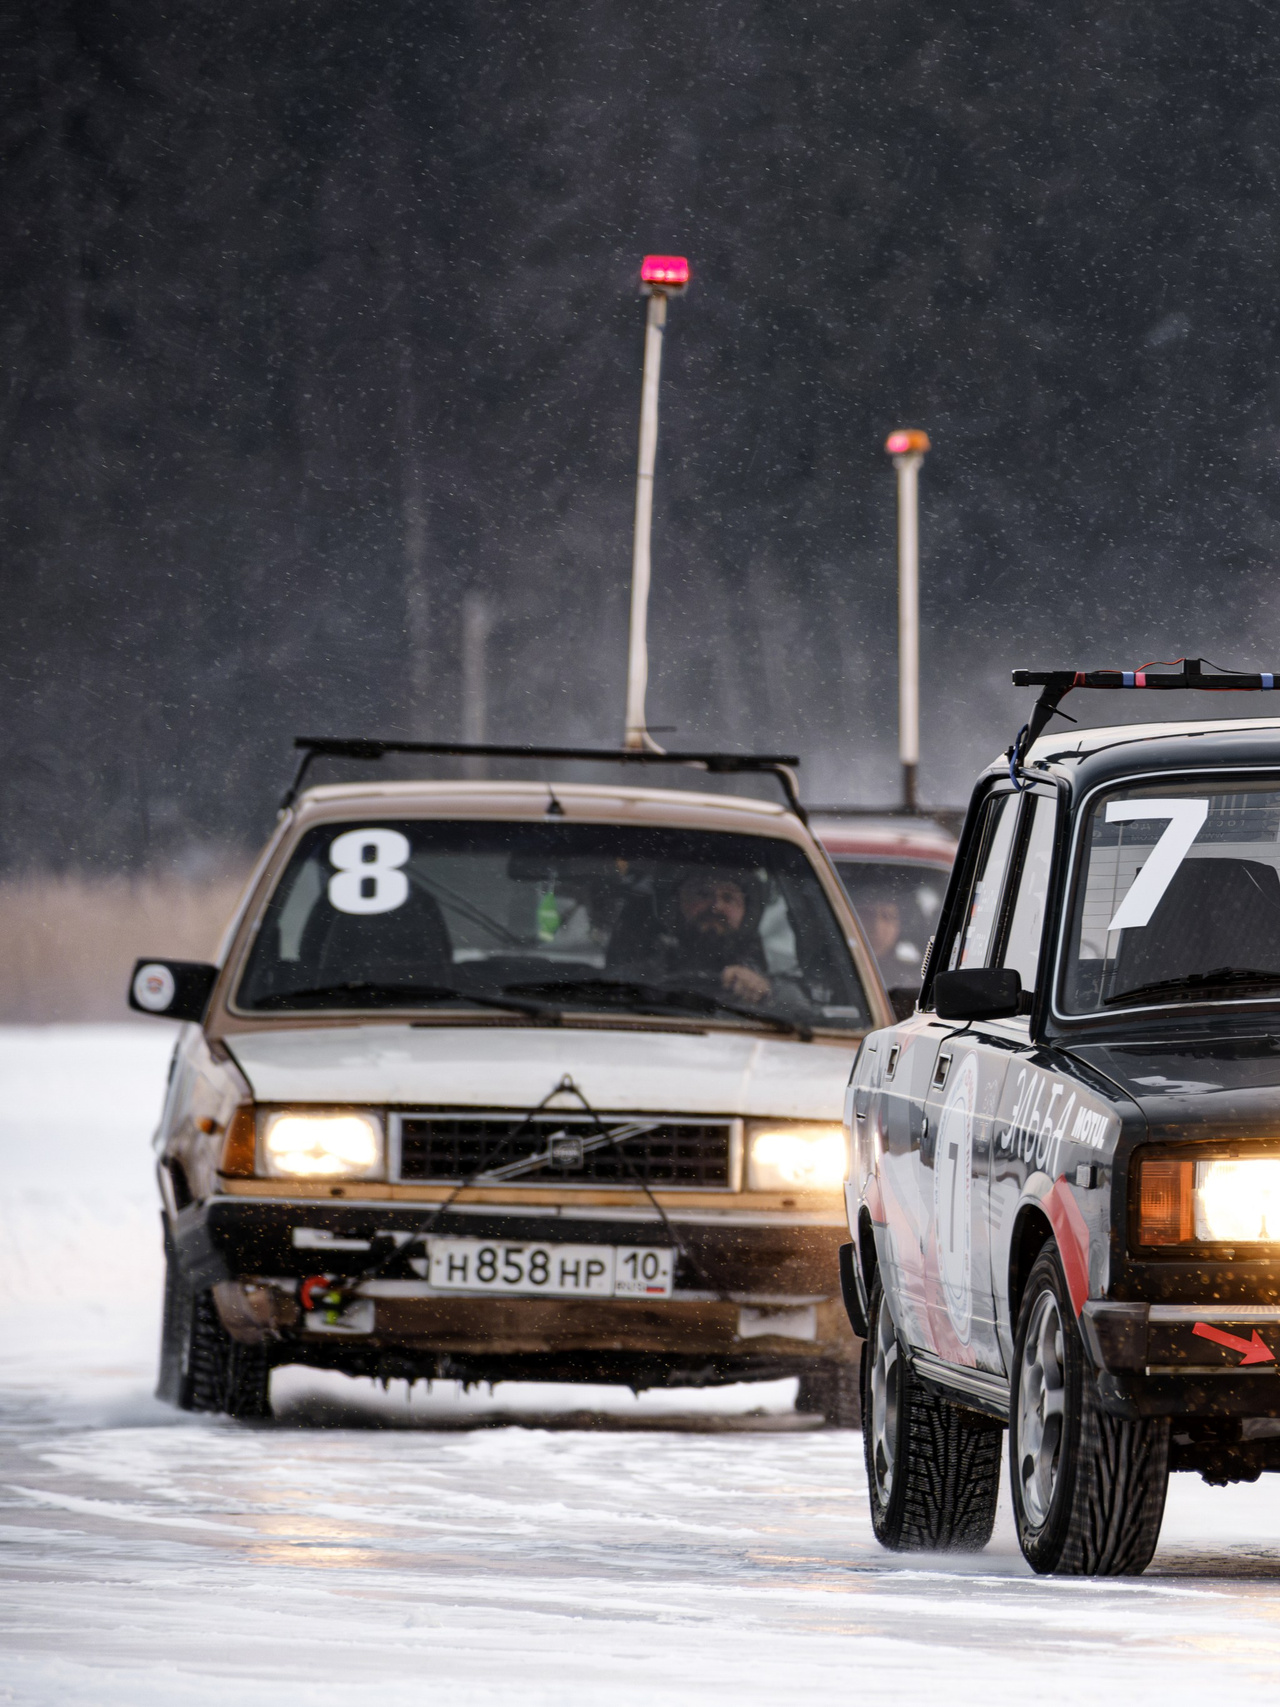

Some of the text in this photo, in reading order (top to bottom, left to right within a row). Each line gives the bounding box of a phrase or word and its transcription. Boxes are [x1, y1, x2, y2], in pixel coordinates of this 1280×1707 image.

[328, 827, 410, 915] 8
[1105, 798, 1209, 930] 7
[1071, 1106, 1109, 1149] MOTUL
[624, 1251, 659, 1280] 10
